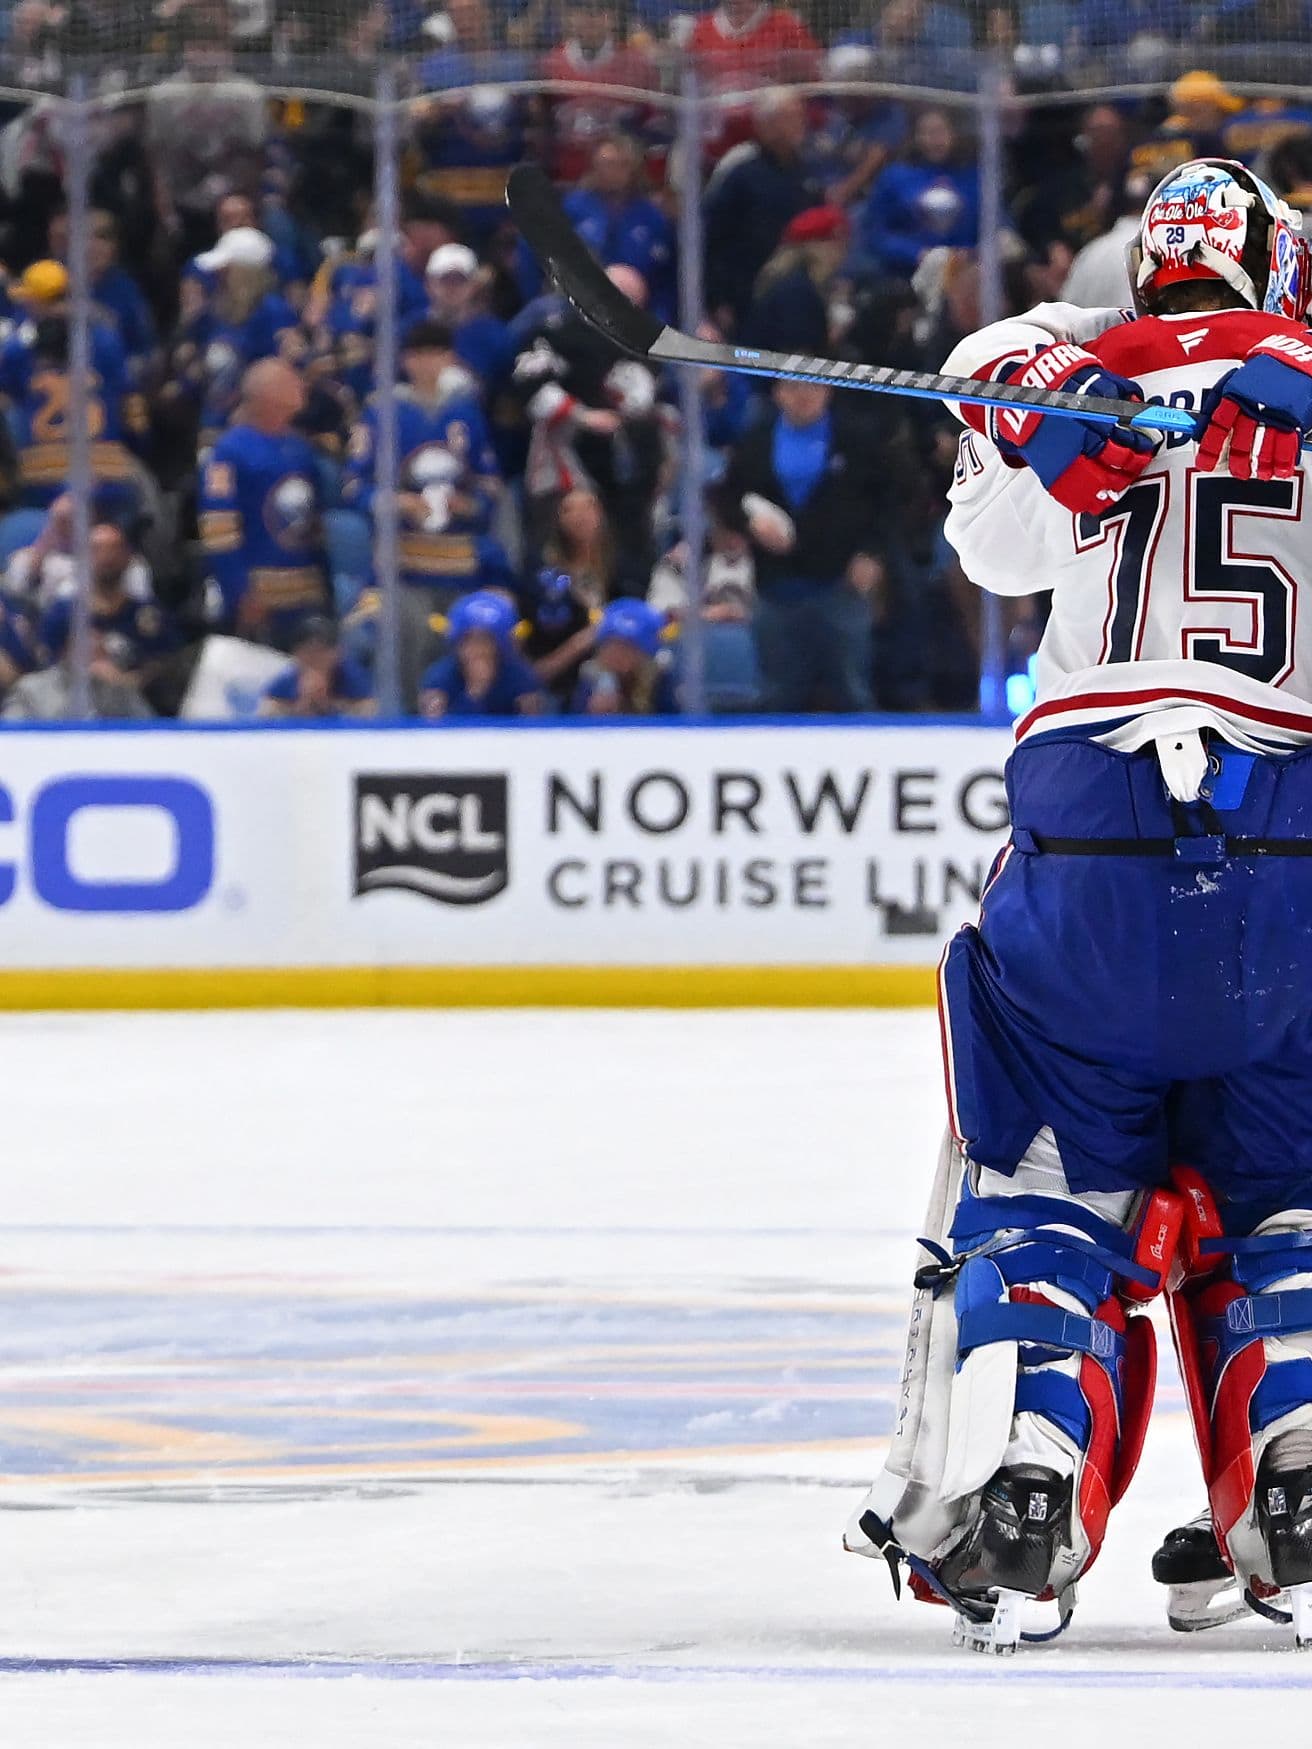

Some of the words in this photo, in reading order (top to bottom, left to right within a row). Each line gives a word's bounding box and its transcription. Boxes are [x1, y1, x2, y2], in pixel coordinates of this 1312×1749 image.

[1166, 226, 1185, 245] 29
[1071, 466, 1305, 688] 75
[359, 793, 504, 852] NCL
[546, 769, 1010, 835] NORWEG
[0, 773, 216, 913] O
[547, 859, 830, 908] CRUISE
